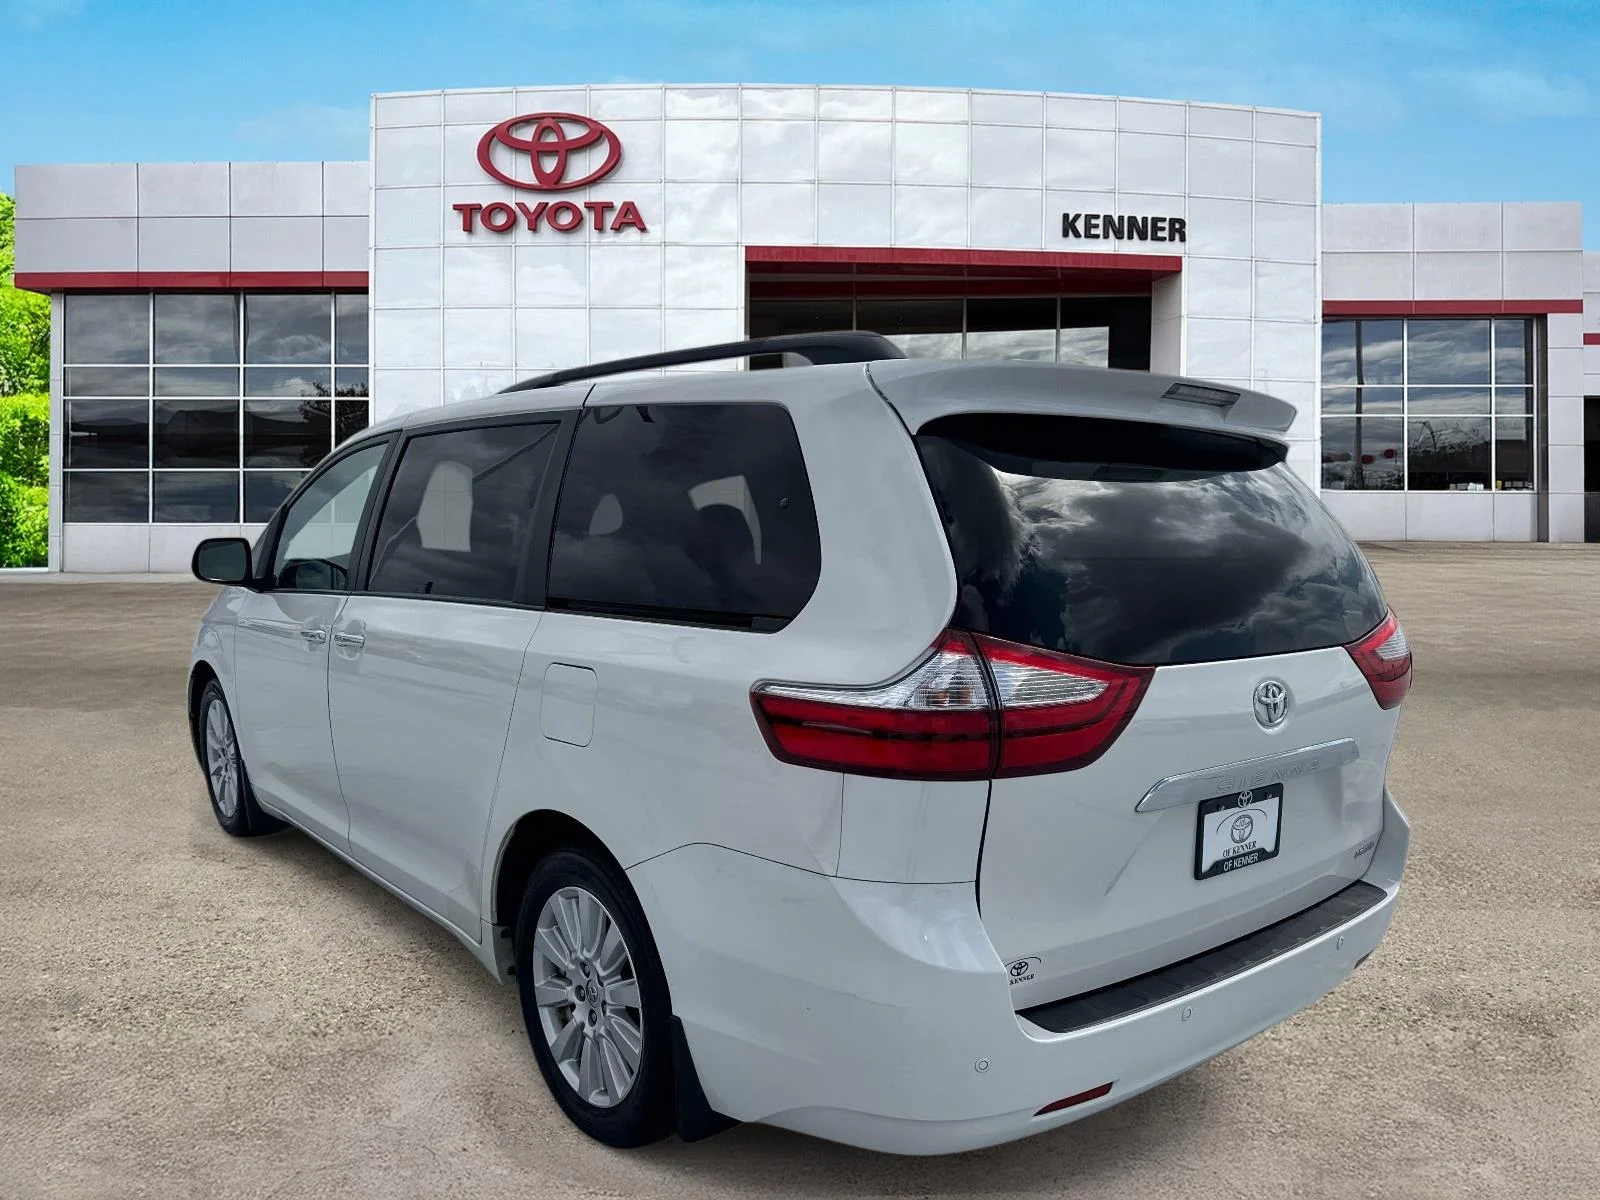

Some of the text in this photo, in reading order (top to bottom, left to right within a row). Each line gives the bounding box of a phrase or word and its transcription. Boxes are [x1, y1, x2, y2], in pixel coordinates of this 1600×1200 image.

[452, 200, 648, 233] TOYOTA
[1062, 212, 1187, 242] KENNER
[1216, 759, 1320, 793] SIENNA
[1222, 840, 1257, 857] OF KENNER
[1223, 852, 1259, 871] OF KENNER
[1009, 973, 1035, 986] KENNER
